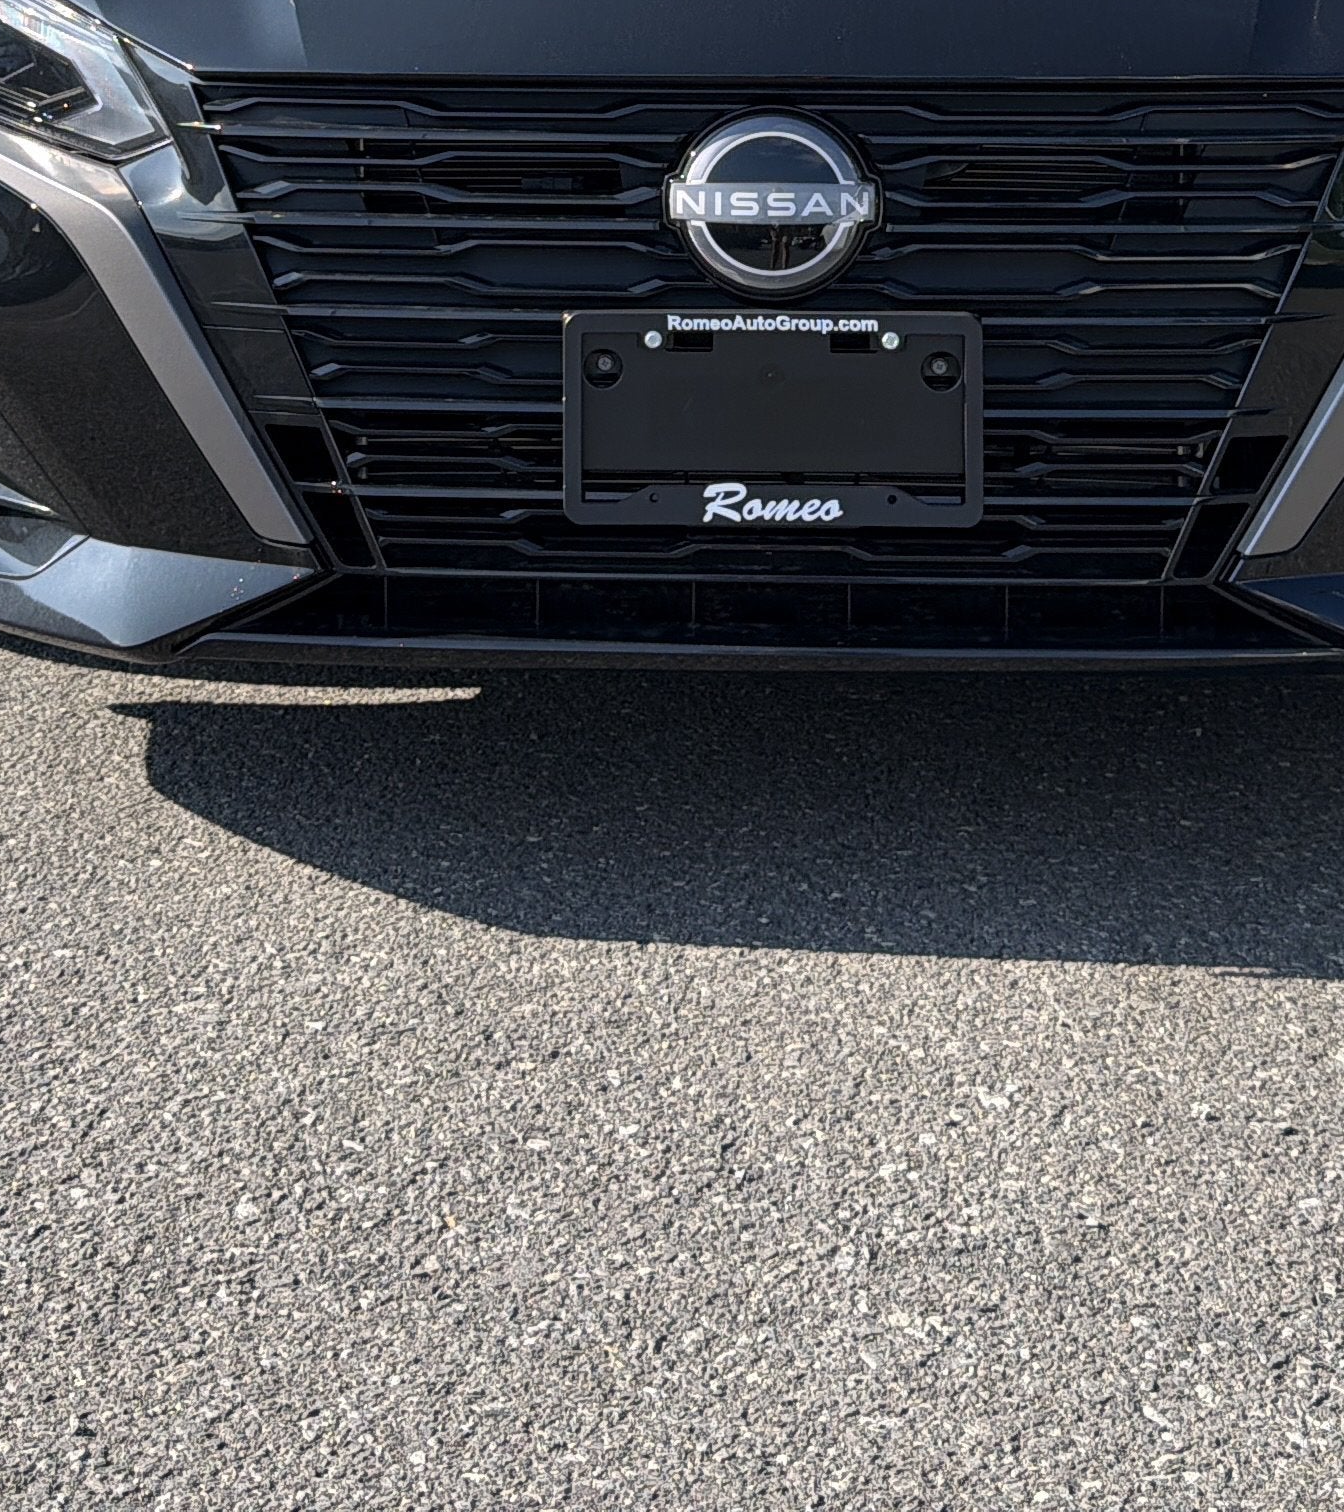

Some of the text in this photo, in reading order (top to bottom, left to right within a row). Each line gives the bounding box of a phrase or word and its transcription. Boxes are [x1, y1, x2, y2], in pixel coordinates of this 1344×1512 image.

[676, 190, 869, 216] NISSAN
[667, 315, 879, 334] RomeoAutoGroup.com
[703, 482, 844, 523] Romeo
